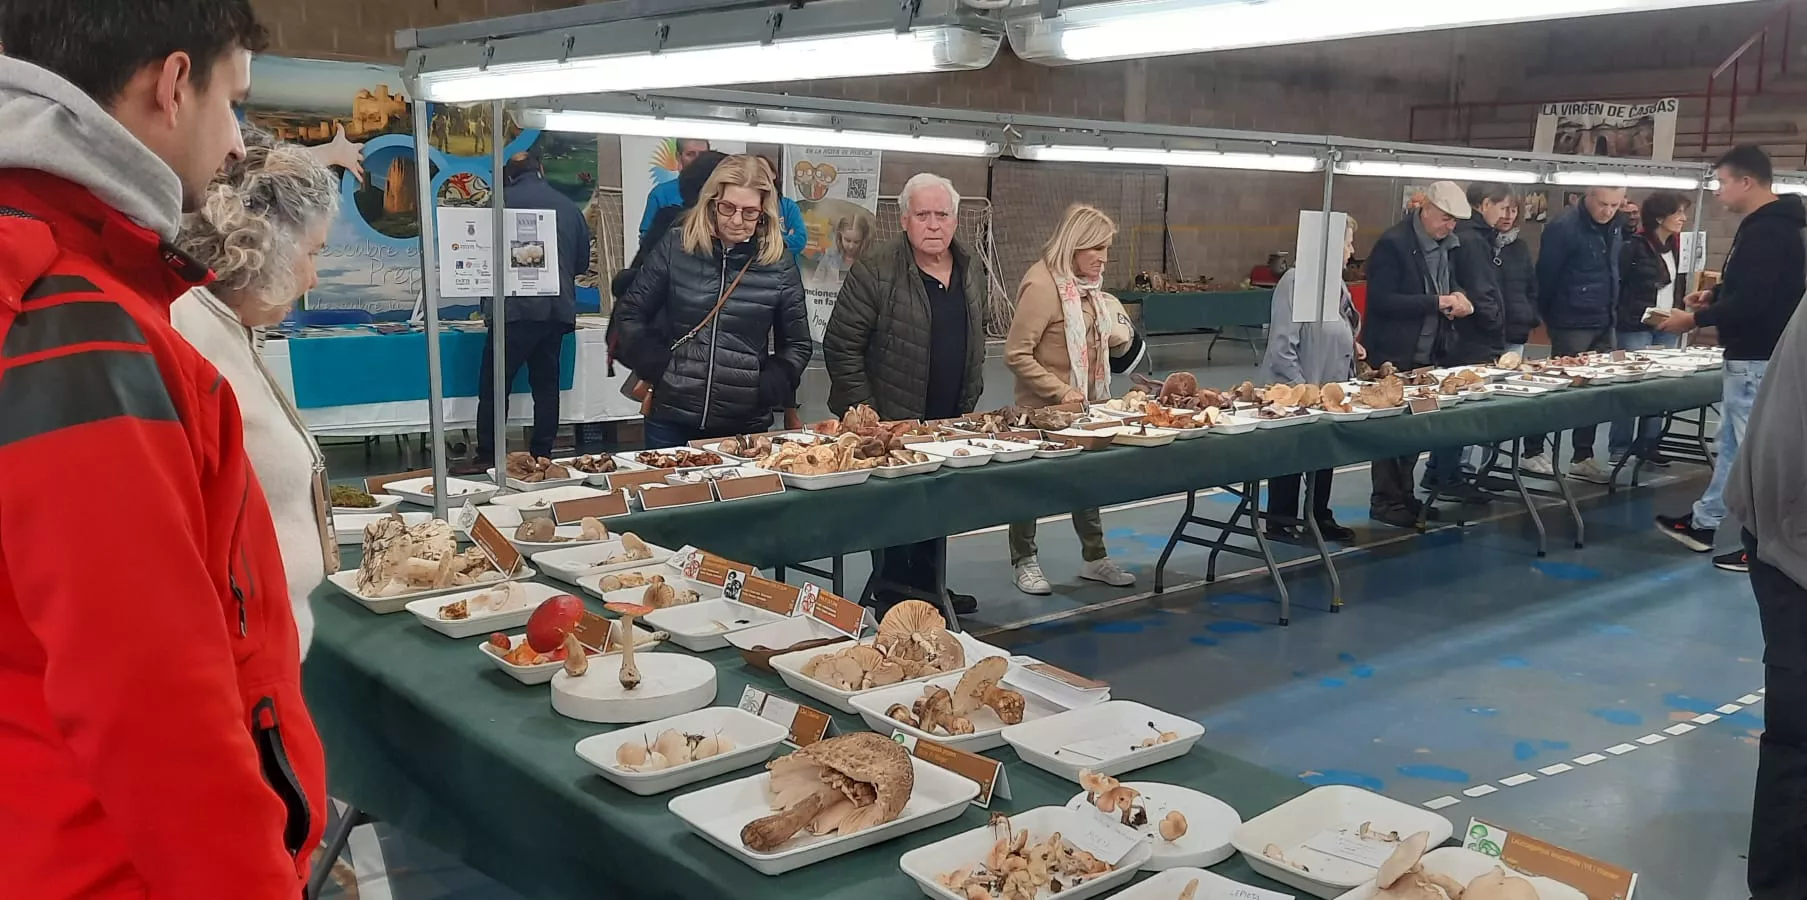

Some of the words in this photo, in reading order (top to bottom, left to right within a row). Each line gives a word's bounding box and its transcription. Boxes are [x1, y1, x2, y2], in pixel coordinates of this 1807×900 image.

[1543, 104, 1557, 115] LA
[1561, 103, 1604, 115] VIRGEN
[1607, 105, 1625, 117] DE
[320, 237, 399, 257] escubre
[369, 257, 422, 294] Prep
[825, 298, 834, 306] fa
